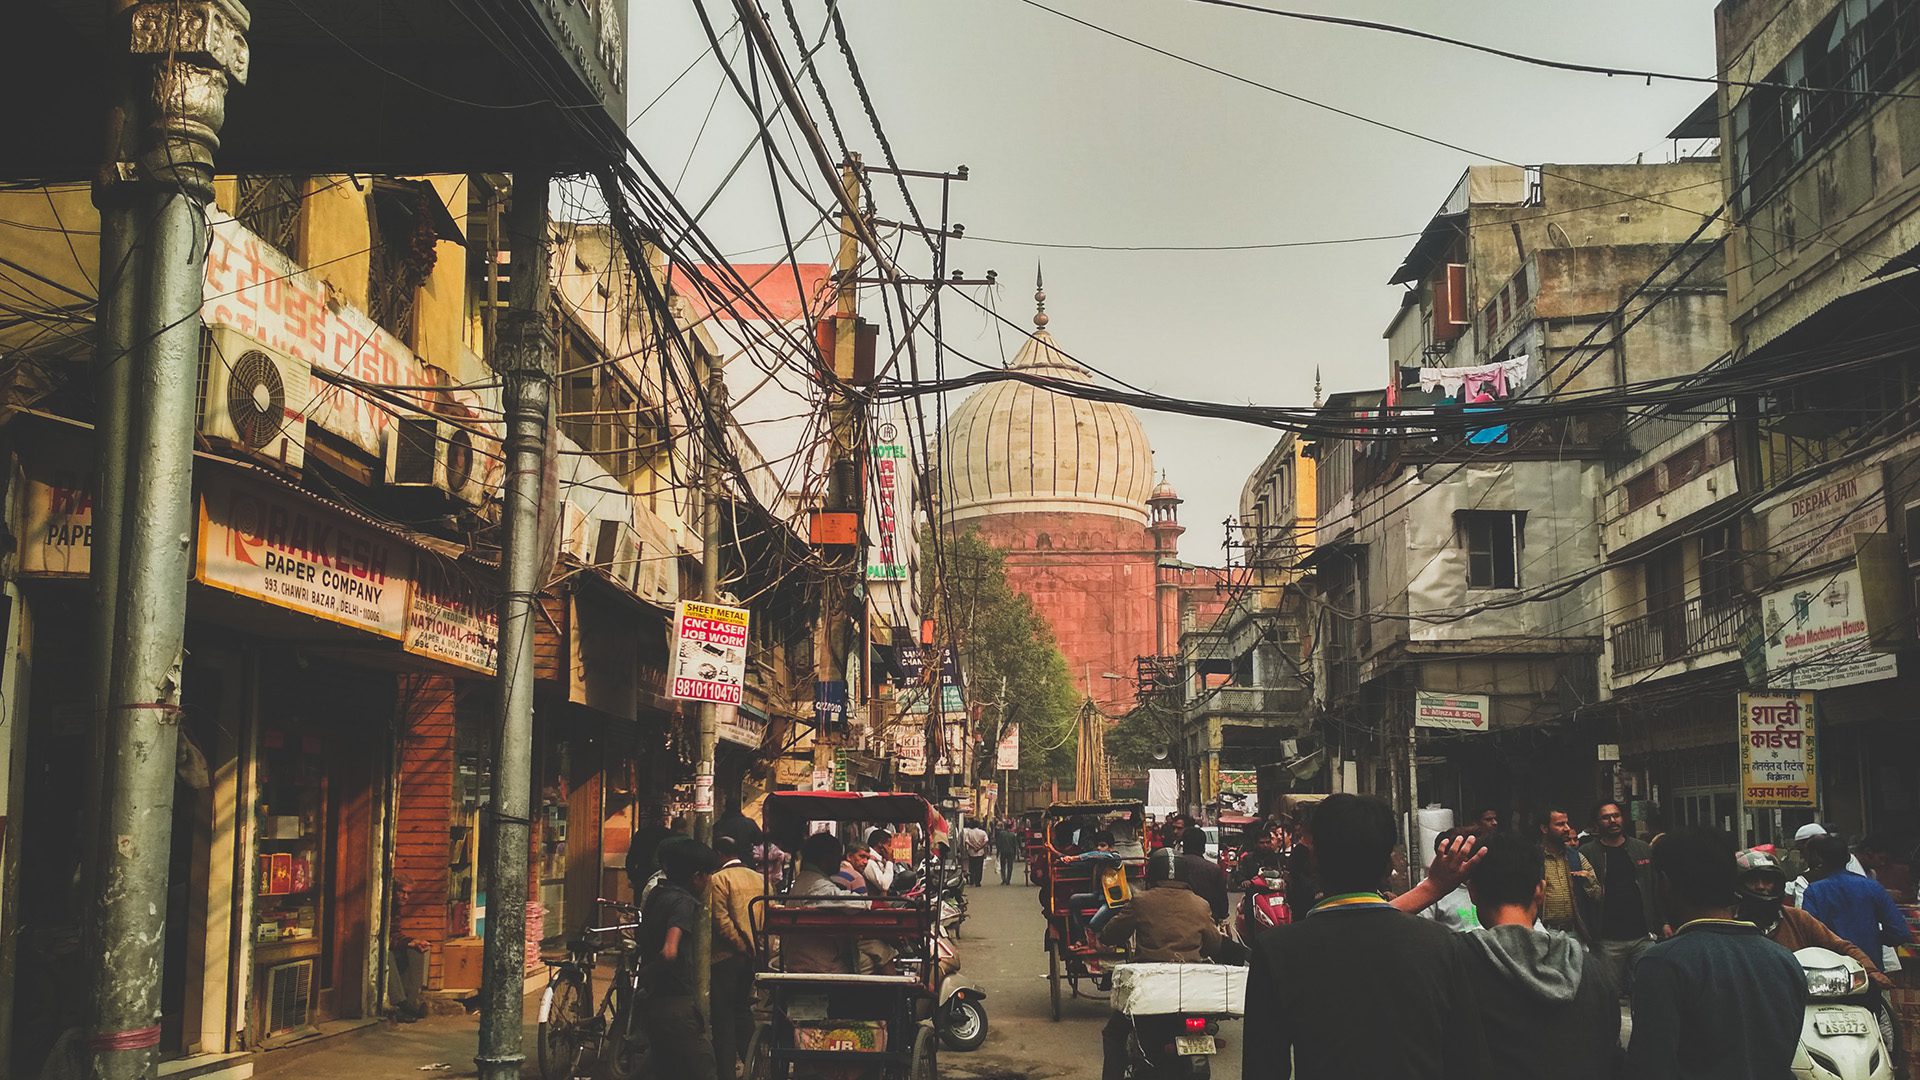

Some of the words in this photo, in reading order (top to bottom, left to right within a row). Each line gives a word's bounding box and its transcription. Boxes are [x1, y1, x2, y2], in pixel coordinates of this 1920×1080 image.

[1792, 490, 1831, 518] DEEPAK
[1834, 478, 1858, 502] JAIN
[47, 525, 92, 546] PAPE
[267, 502, 389, 585] RAKESH
[265, 551, 316, 584] PAPER
[322, 569, 383, 605] COMPANY
[281, 584, 309, 601] CHAWRI
[687, 603, 715, 615] SHEET
[717, 609, 745, 621] METAL
[410, 612, 461, 641] NATIONAL
[684, 617, 708, 630] CNC
[710, 621, 745, 636] LASER
[1843, 620, 1866, 637] House
[682, 629, 706, 641] JOB
[708, 632, 744, 647] WORK
[433, 644, 463, 659] CHAWRI
[676, 679, 740, 702] 9810110476
[1751, 701, 1802, 725] शादी
[1748, 786, 1775, 798] अजय
[830, 1040, 854, 1051] JR
